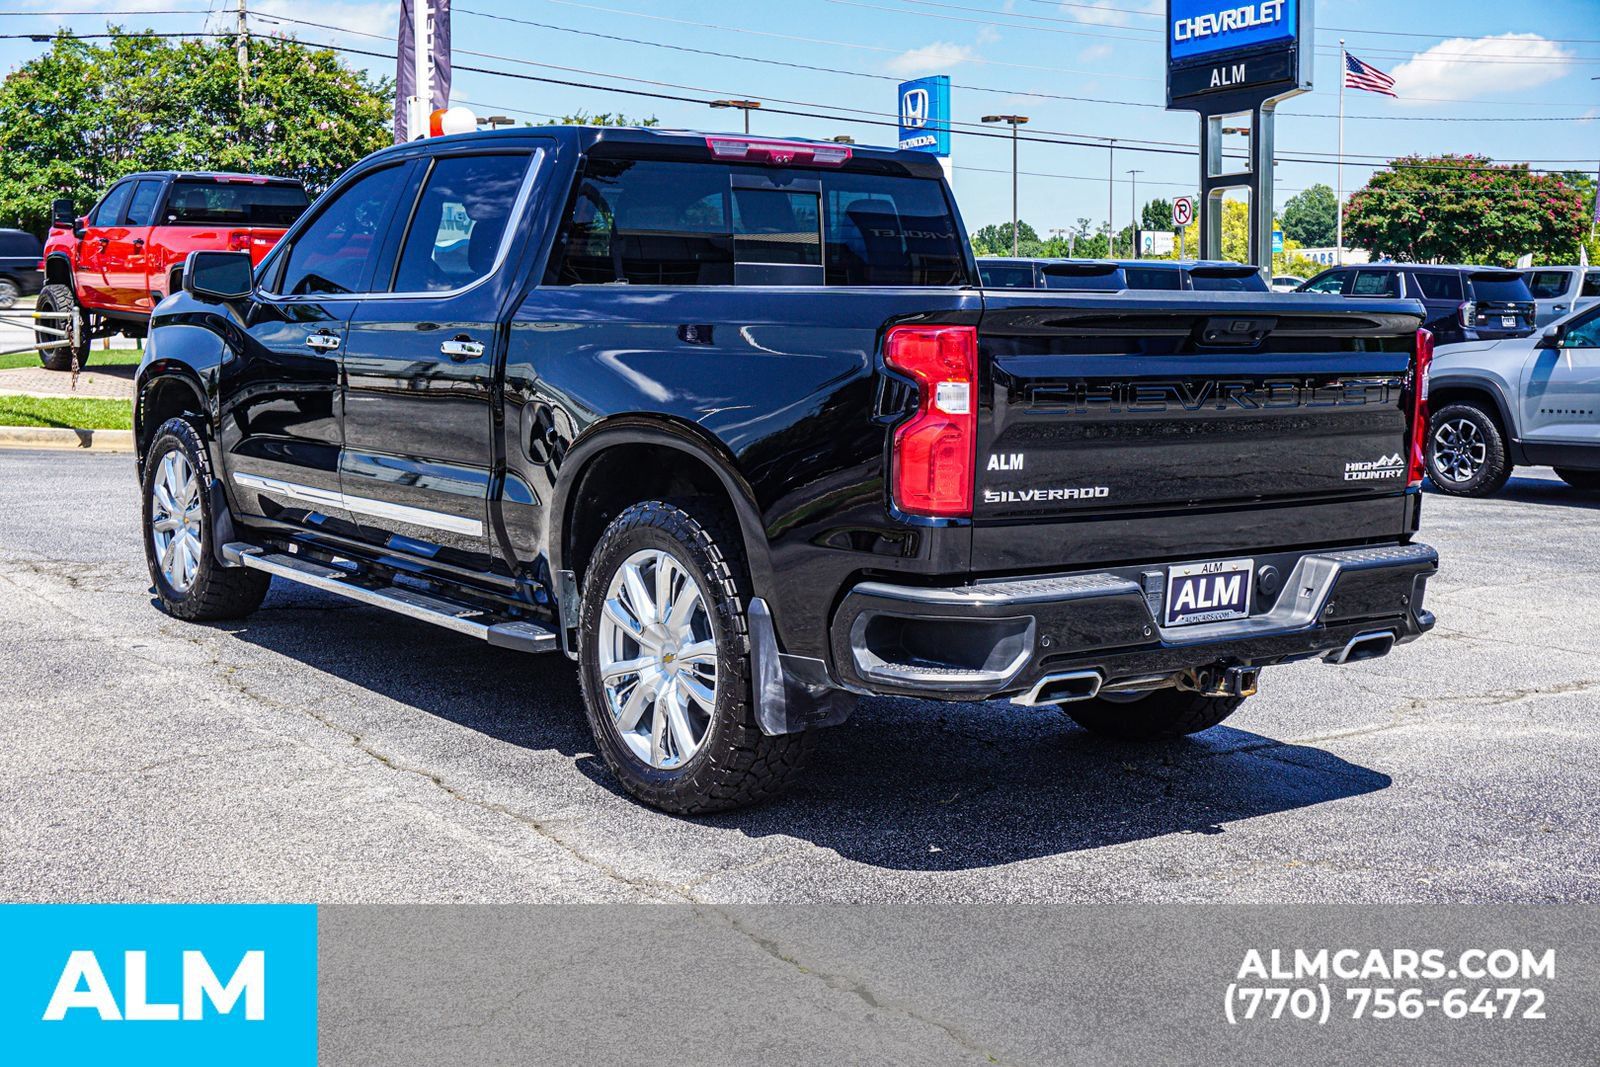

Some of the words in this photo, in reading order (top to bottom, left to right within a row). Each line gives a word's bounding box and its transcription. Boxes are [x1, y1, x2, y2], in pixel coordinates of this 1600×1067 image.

[1174, 0, 1285, 41] CHEVROLET
[1209, 64, 1246, 88] ALM
[1306, 252, 1334, 265] ARS
[987, 453, 1024, 471] ALM
[1345, 461, 1377, 471] HIGH
[1344, 468, 1404, 481] COUNTRY
[984, 486, 1110, 503] SILVERADO
[1201, 562, 1223, 574] ALM
[1173, 575, 1242, 611] ALM
